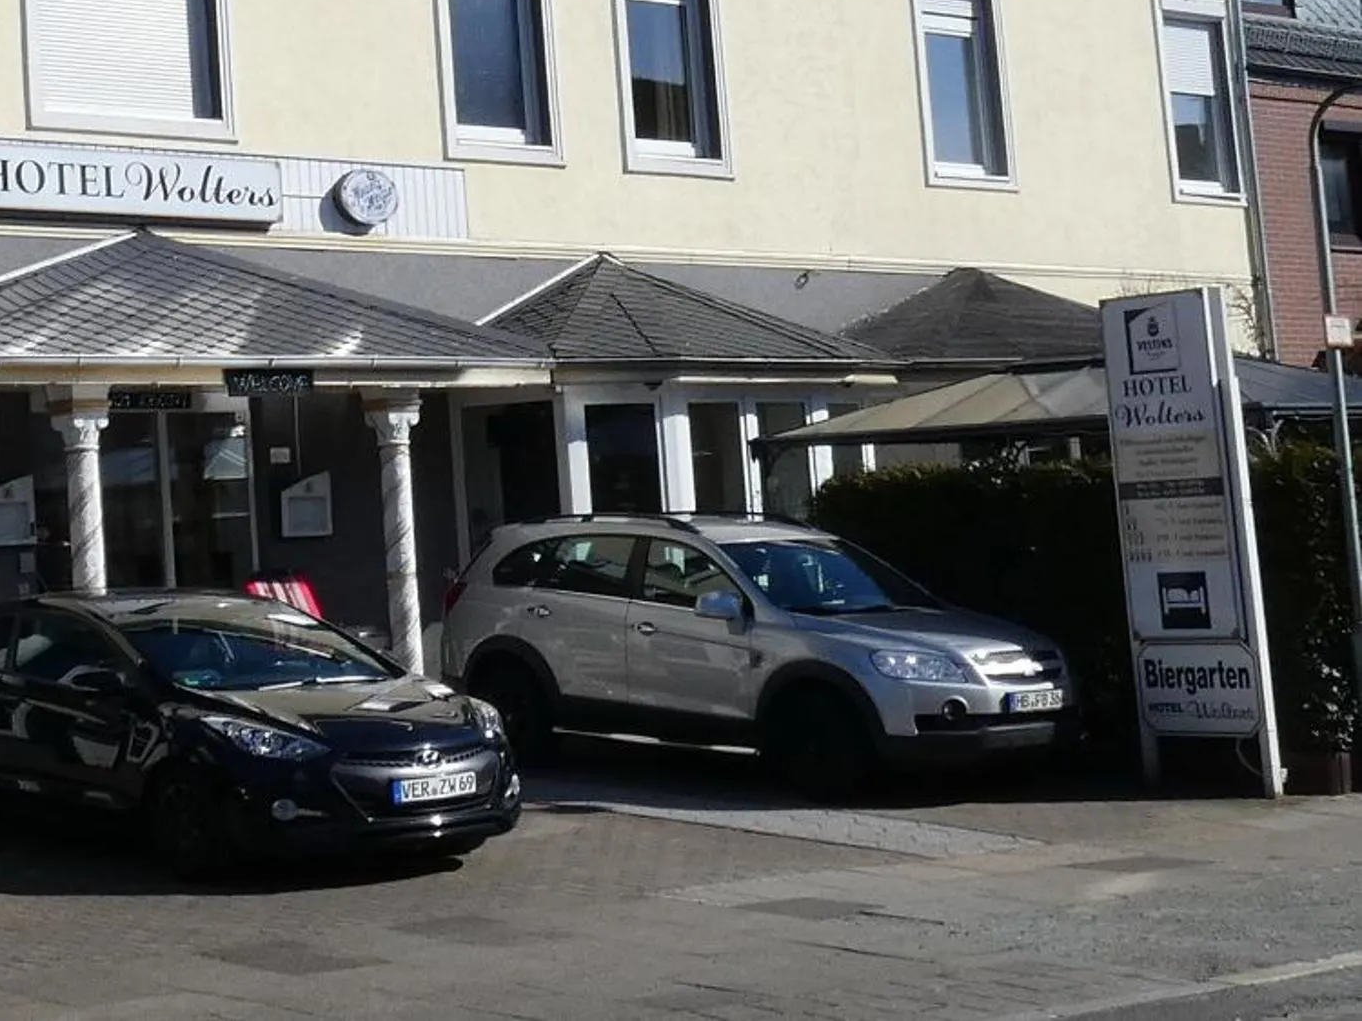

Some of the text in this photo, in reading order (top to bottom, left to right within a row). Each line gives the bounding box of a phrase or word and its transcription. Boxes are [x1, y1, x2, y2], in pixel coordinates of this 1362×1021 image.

[124, 160, 279, 207] Wolters
[1122, 375, 1192, 397] HOTEL
[1115, 401, 1205, 428] Wolters
[1144, 659, 1251, 694] Biergarten
[402, 775, 475, 799] VER ZW 69
